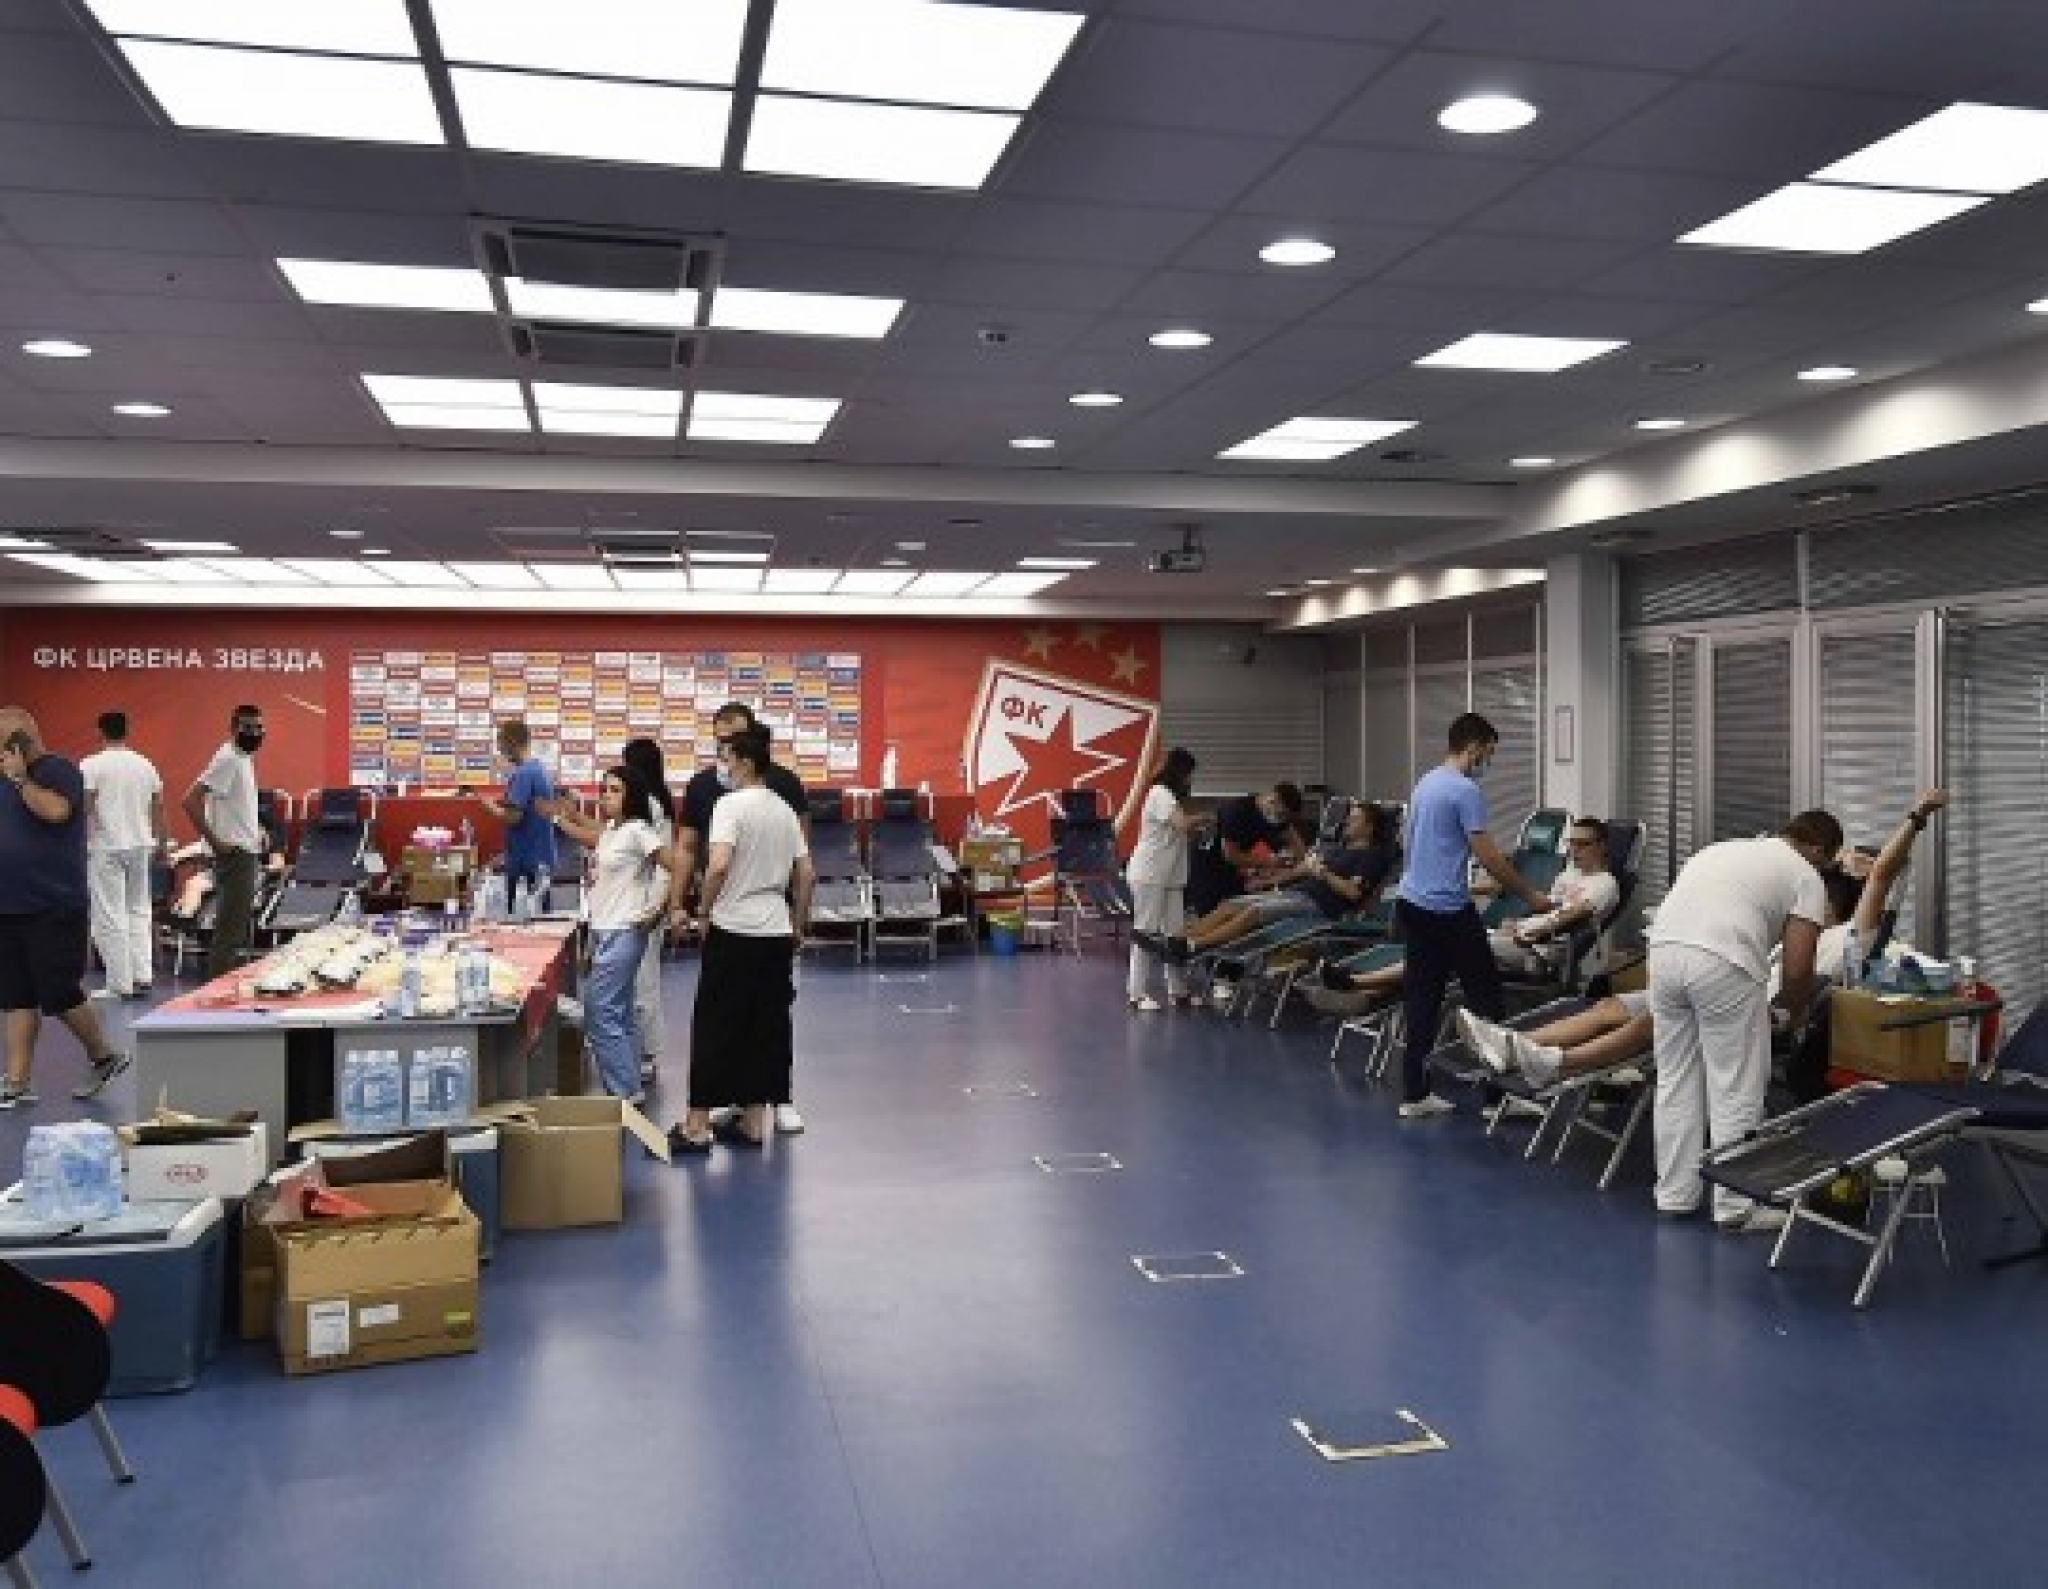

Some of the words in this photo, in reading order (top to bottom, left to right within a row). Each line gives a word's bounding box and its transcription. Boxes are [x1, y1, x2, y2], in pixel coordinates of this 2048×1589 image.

[33, 648, 77, 669] ФК
[86, 648, 203, 671] ЦРВЕНА
[213, 648, 324, 672] ЗВЕЗДА
[1000, 695, 1050, 728] ФК
